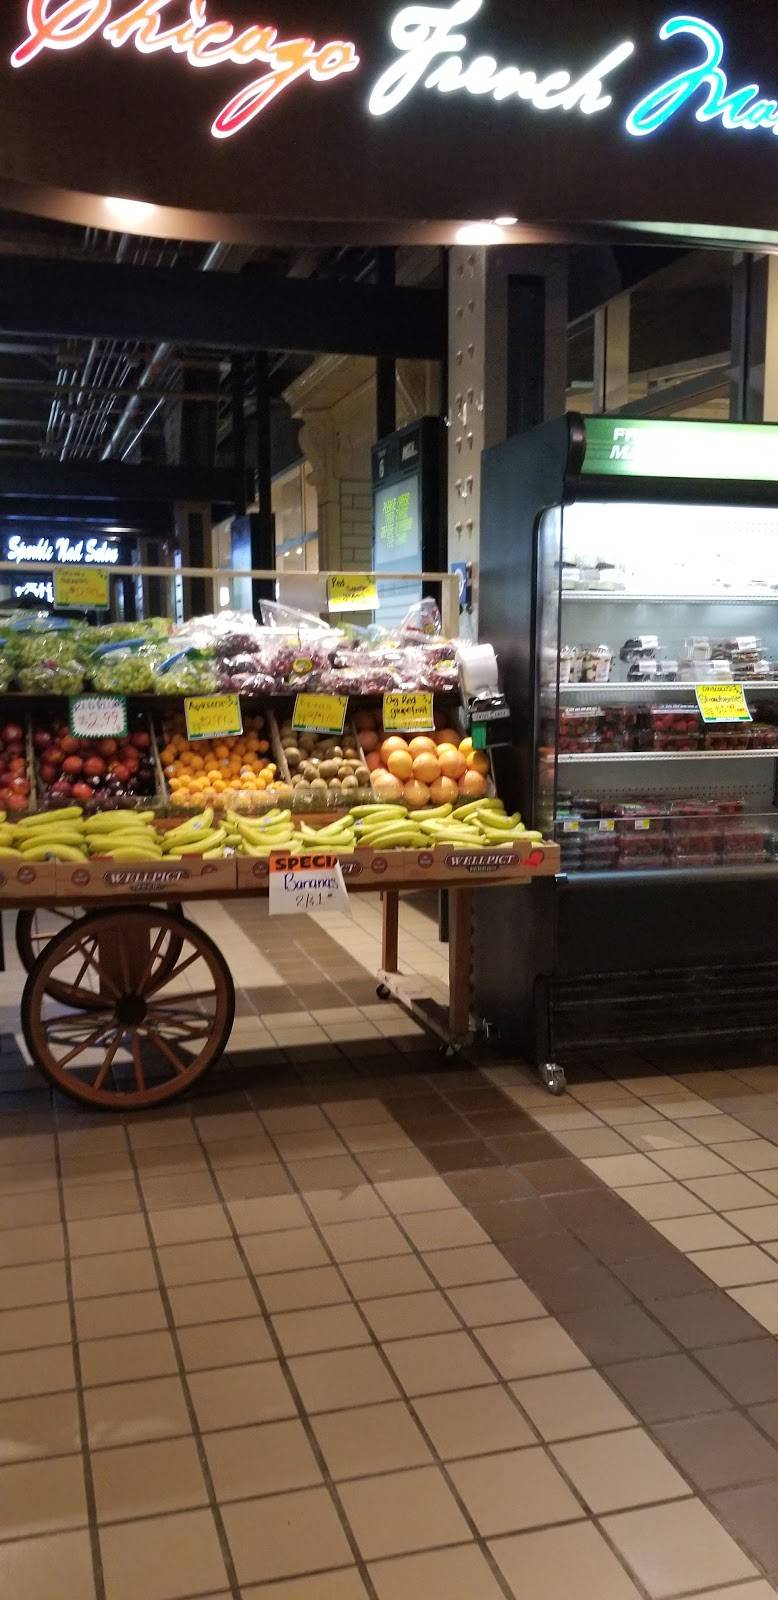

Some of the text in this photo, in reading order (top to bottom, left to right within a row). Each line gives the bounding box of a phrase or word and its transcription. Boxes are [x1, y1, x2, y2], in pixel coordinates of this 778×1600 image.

[10, 0, 778, 139] Chicago French Ma
[284, 873, 339, 891] Bananas
